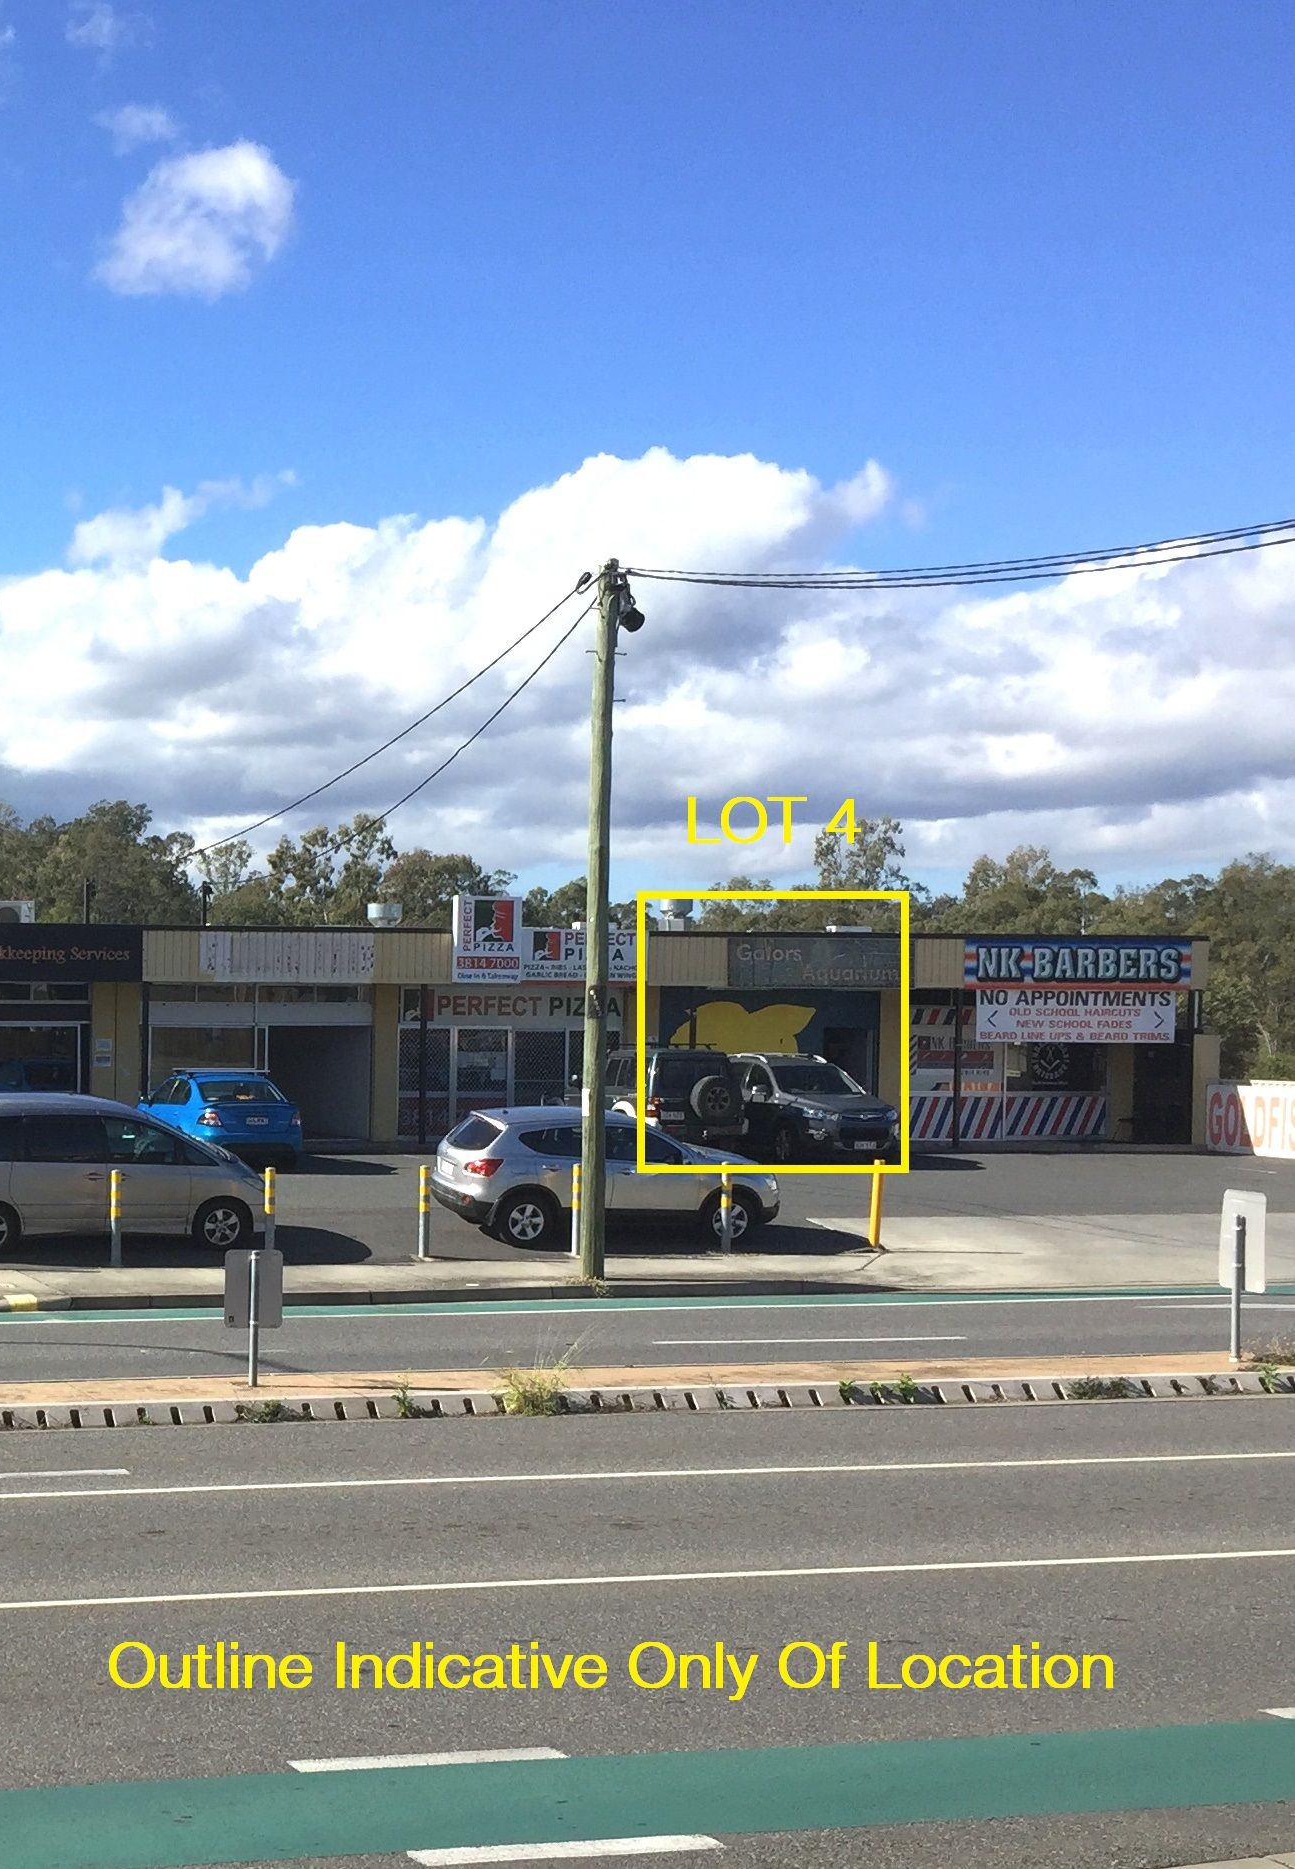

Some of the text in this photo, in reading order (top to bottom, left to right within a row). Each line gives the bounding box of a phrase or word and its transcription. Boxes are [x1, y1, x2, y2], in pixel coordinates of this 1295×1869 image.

[462, 901, 472, 951] PERFECT
[564, 932, 637, 946] PEECT
[70, 947, 130, 961] Services
[473, 943, 514, 952] PIZZA
[564, 947, 625, 961] PIA
[458, 957, 519, 969] 3814 7000
[977, 946, 1182, 982] NK BARBERS
[979, 989, 1172, 1007] NO APPOINTMENTS
[437, 994, 622, 1017] PERFECT PIZA
[1009, 1007, 1141, 1017] OLD SCHOOL HAIRCUTS
[1016, 1019, 1133, 1029] NEW SCHOOL FADES
[979, 1032, 1170, 1041] BEARD LINE UPS & BEARD TRIMS
